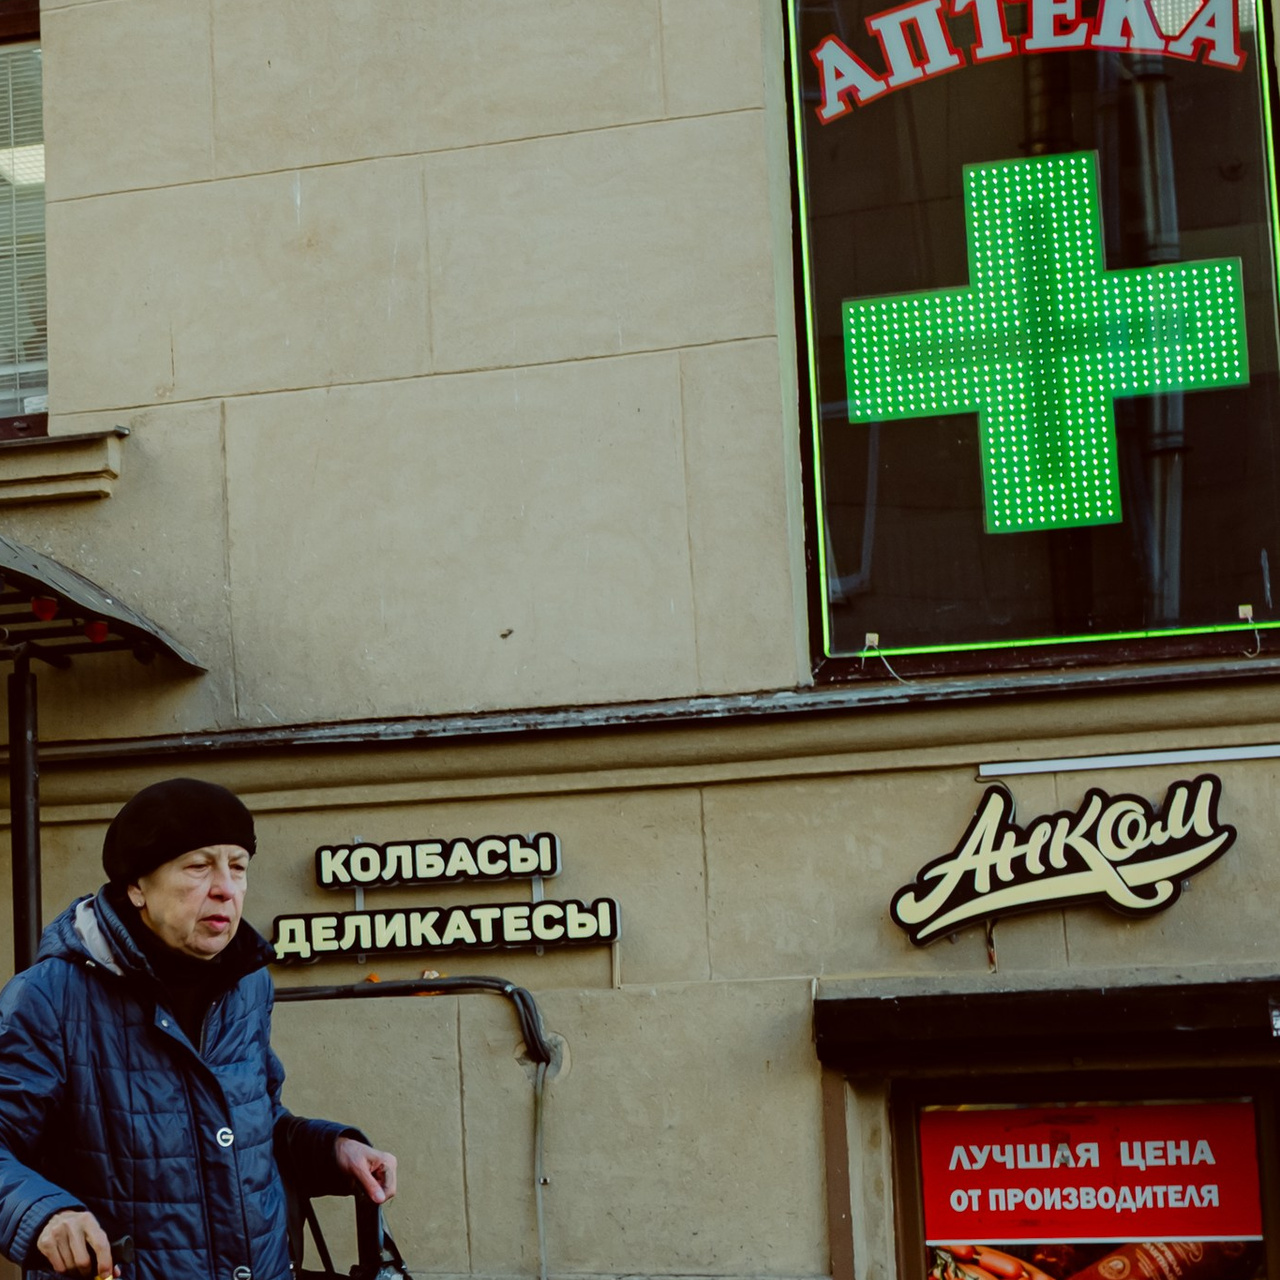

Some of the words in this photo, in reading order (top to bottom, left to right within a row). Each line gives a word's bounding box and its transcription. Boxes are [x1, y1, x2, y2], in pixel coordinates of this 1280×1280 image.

[320, 836, 553, 885] КОЛБАСЫ
[274, 901, 612, 960] ДЕЛИКАТЕСЫ
[949, 1143, 1099, 1170] ЛУЧШАЯ
[1120, 1140, 1216, 1171] ЦЕНА
[950, 1189, 981, 1212] ОТ
[989, 1185, 1219, 1212] ПРОИЗВОДИТЕЛЯ
